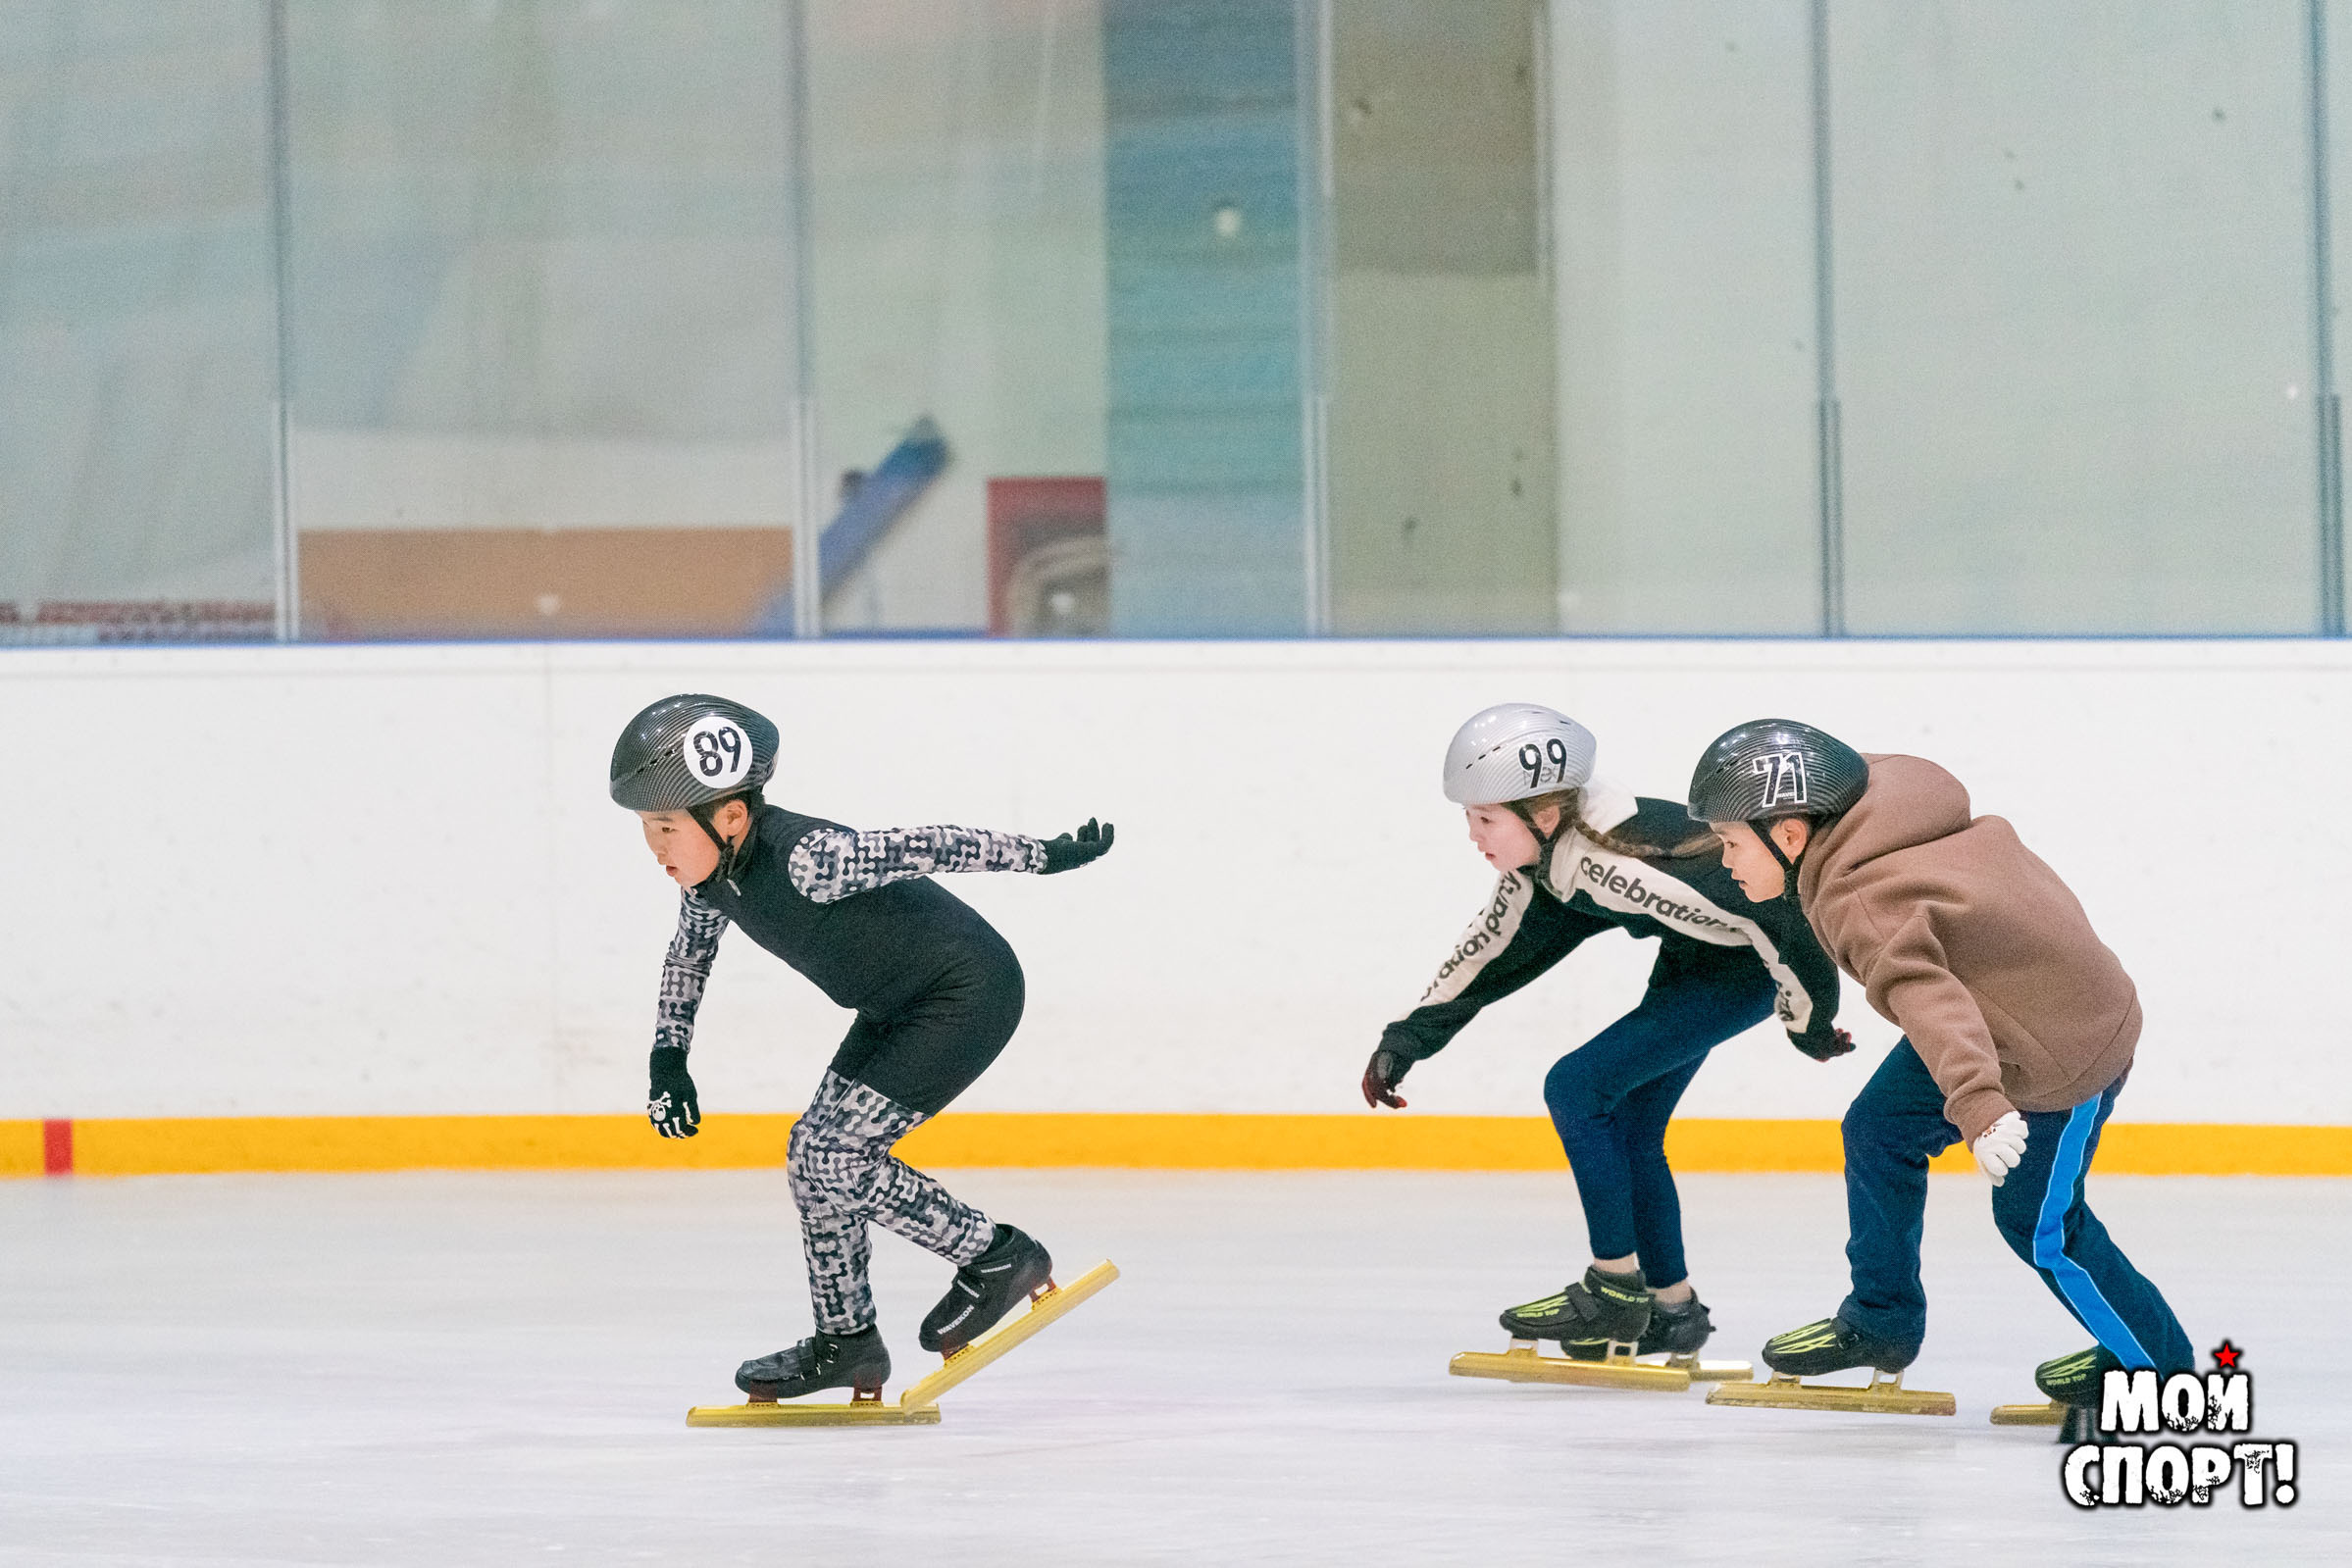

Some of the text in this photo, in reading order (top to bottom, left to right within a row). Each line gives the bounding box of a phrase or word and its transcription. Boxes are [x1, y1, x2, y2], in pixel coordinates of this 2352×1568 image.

[692, 726, 741, 777] 89
[1518, 737, 1567, 789] 99
[1752, 751, 1808, 808] 71
[1484, 870, 1522, 936] party
[1579, 855, 1728, 928] celebration
[937, 1304, 975, 1335] WAVEKON
[1600, 1286, 1636, 1302] WORLD
